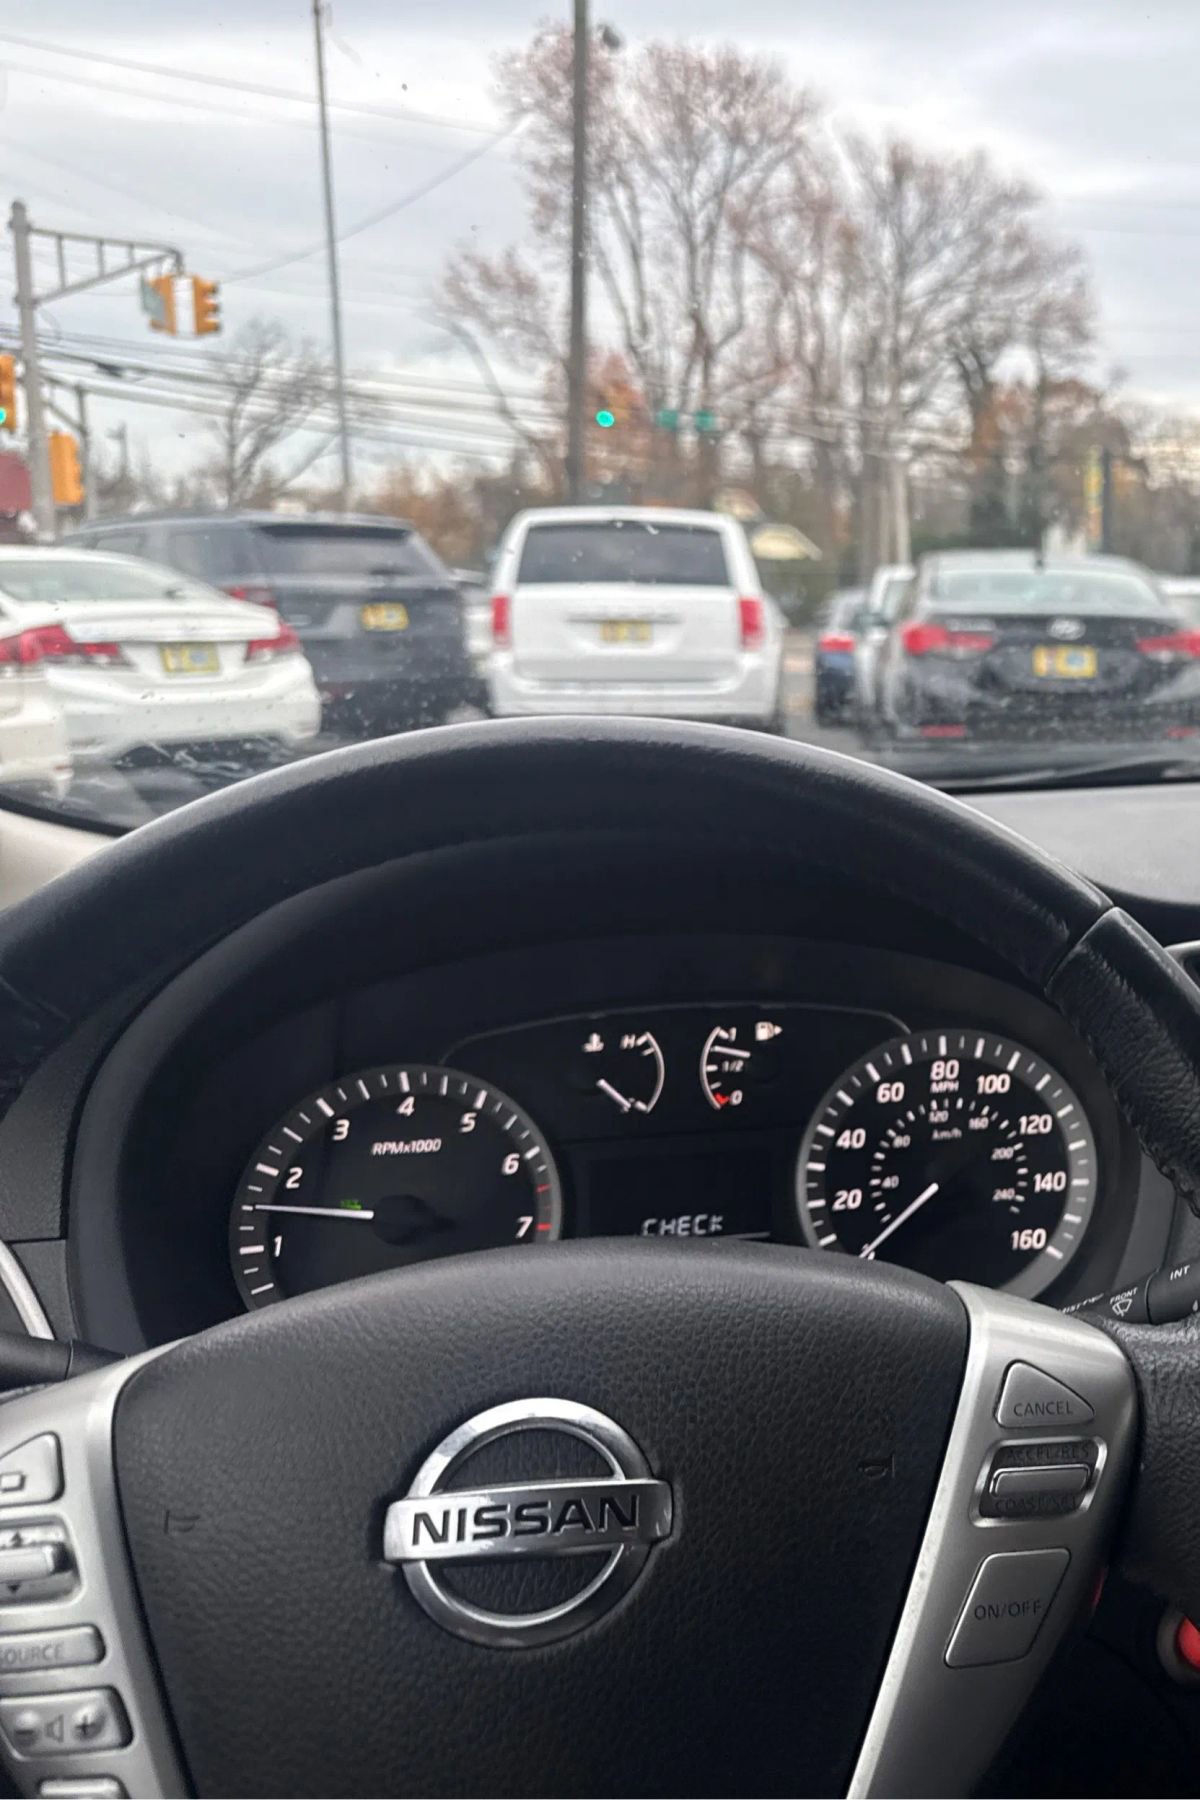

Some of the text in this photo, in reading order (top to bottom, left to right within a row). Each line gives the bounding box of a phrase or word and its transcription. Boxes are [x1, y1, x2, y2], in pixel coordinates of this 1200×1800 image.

[620, 1034, 636, 1049] H
[722, 1059, 744, 1072] 1/2
[930, 1059, 959, 1080] 80
[876, 1081, 905, 1103] 60
[930, 1081, 960, 1093] MPH
[977, 1073, 1011, 1094] 100
[396, 1096, 415, 1117] 4
[332, 1119, 350, 1141] 3
[459, 1112, 477, 1134] 5
[969, 1117, 990, 1130] 160
[1019, 1114, 1053, 1135] 120
[372, 1138, 443, 1155] RPMx1000
[836, 1128, 867, 1149] 40
[501, 1153, 520, 1175] 6
[991, 1147, 1014, 1160] 200
[285, 1167, 303, 1189] 2
[882, 1175, 900, 1189] 40
[1033, 1171, 1066, 1193] 140
[832, 1188, 862, 1211] 20
[992, 1188, 1015, 1202] 240
[516, 1216, 533, 1238] 7
[641, 1214, 724, 1236] CHECK
[273, 1235, 283, 1257] 1
[1011, 1228, 1047, 1250] 160
[1169, 1265, 1191, 1280] INT
[1110, 1287, 1138, 1304] FRONT
[1013, 1401, 1073, 1417] CANCEL
[412, 1495, 640, 1546] NISSAN
[974, 1599, 1042, 1620] ON/OFF
